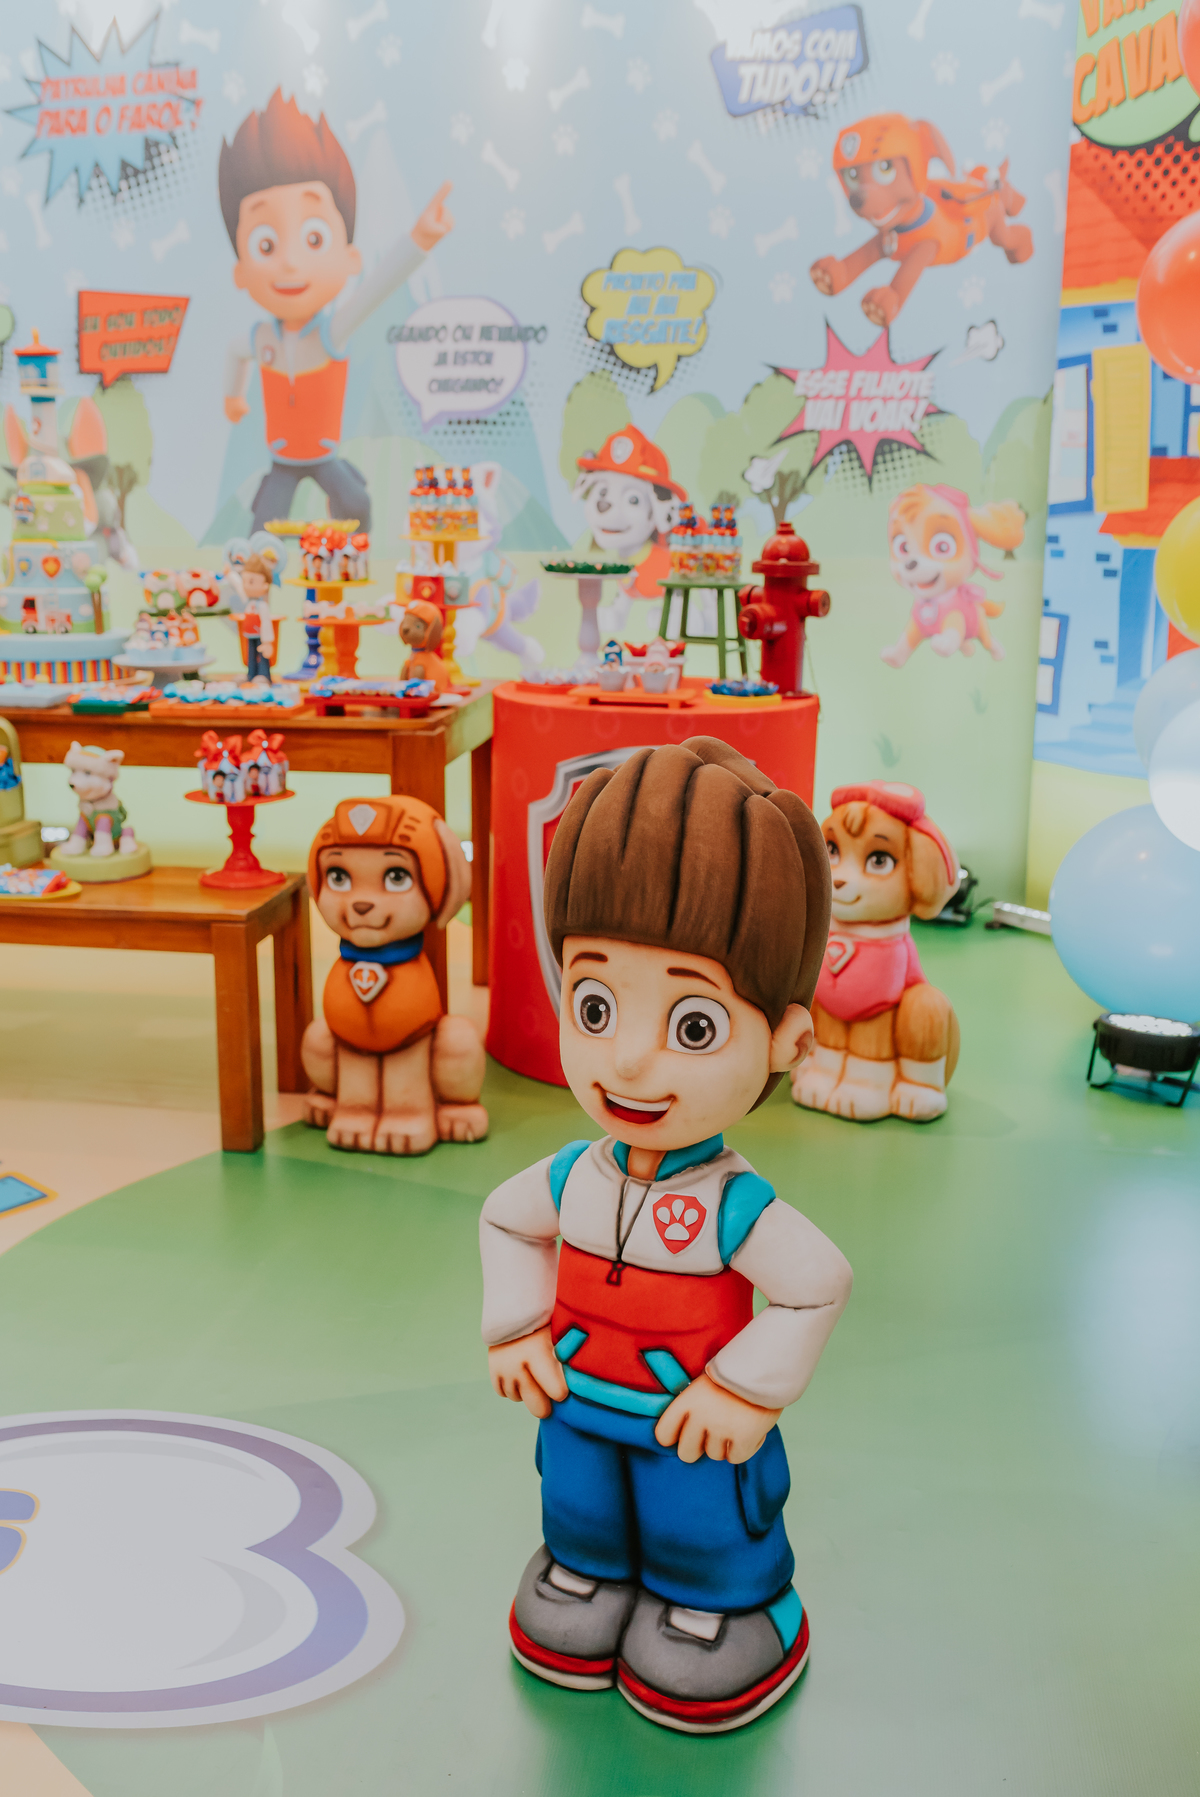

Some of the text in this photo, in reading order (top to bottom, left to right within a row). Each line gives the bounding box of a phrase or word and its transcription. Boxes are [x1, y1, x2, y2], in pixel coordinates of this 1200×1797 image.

[804, 28, 858, 61] COM
[738, 60, 850, 106] TUDO!!
[1072, 9, 1184, 125] CAVA
[36, 107, 88, 138] PARA
[95, 104, 112, 135] O
[793, 369, 935, 398] ESSE FILHOTE
[804, 398, 929, 433] VAI VOAR!
